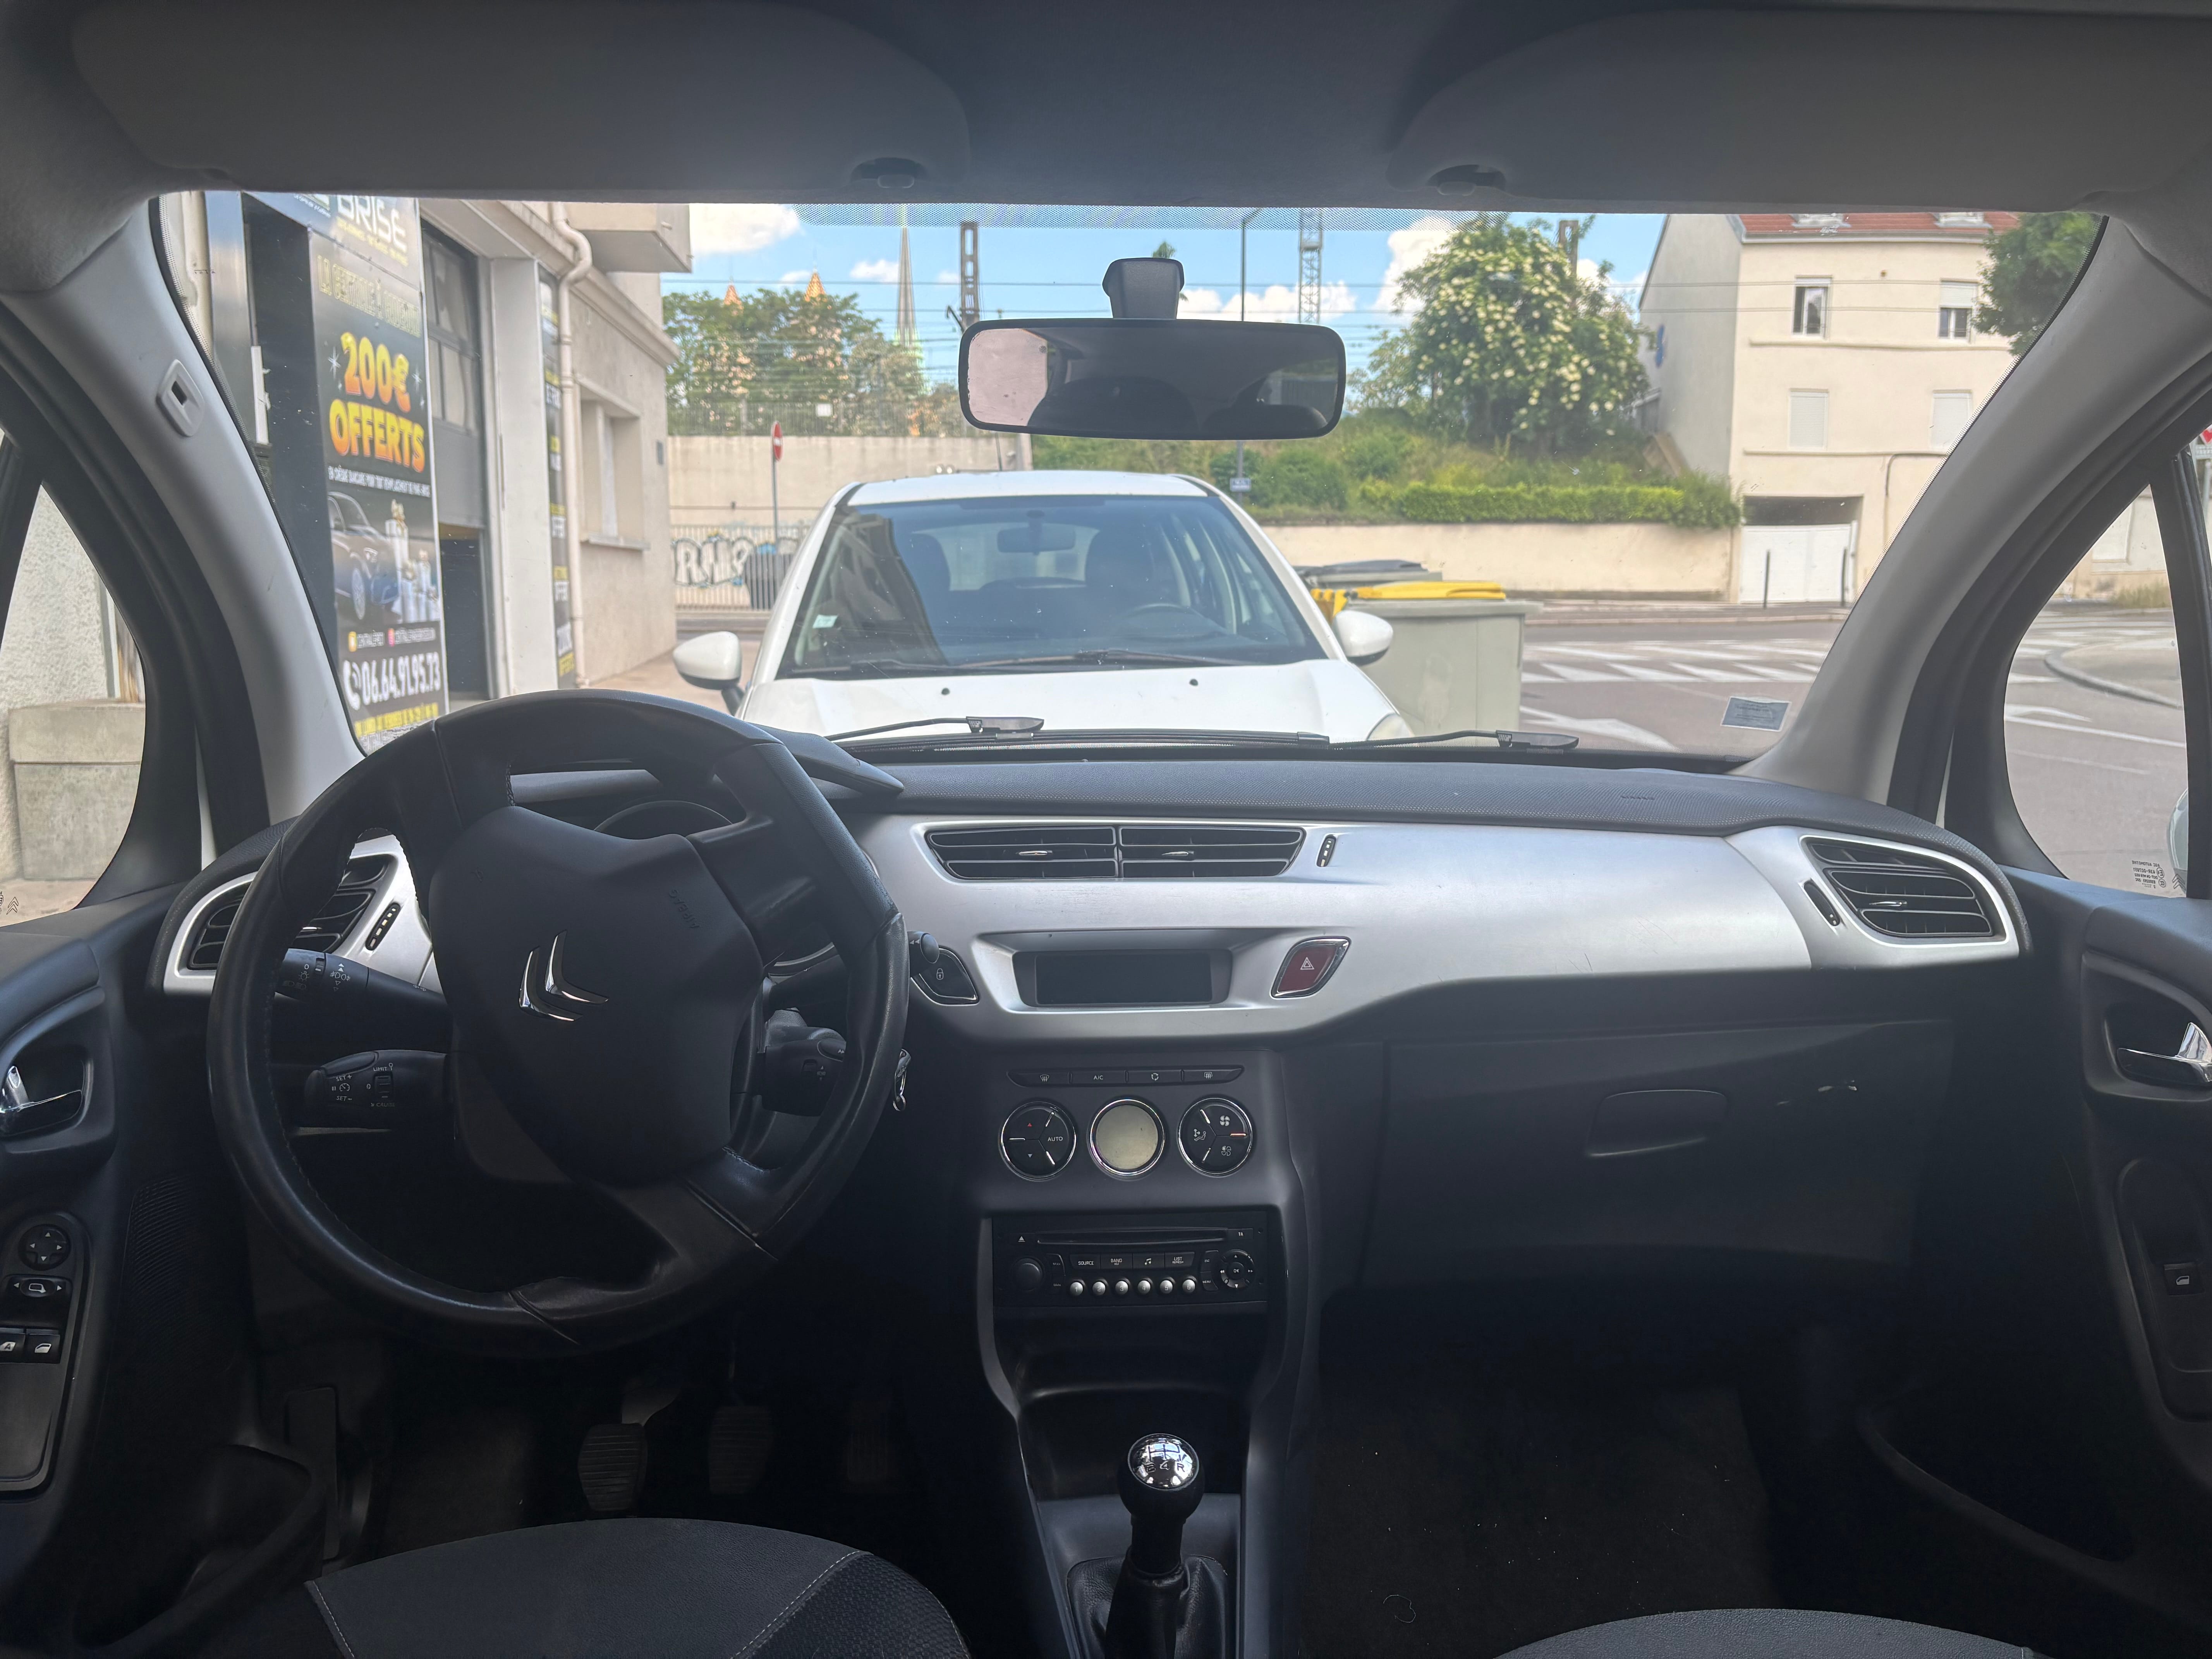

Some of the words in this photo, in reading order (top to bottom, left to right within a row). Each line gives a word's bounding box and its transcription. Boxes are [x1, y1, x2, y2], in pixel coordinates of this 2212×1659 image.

[340, 332, 411, 413] 200€
[329, 399, 425, 473] OFFERTS
[1176, 1463, 1185, 1472] R
